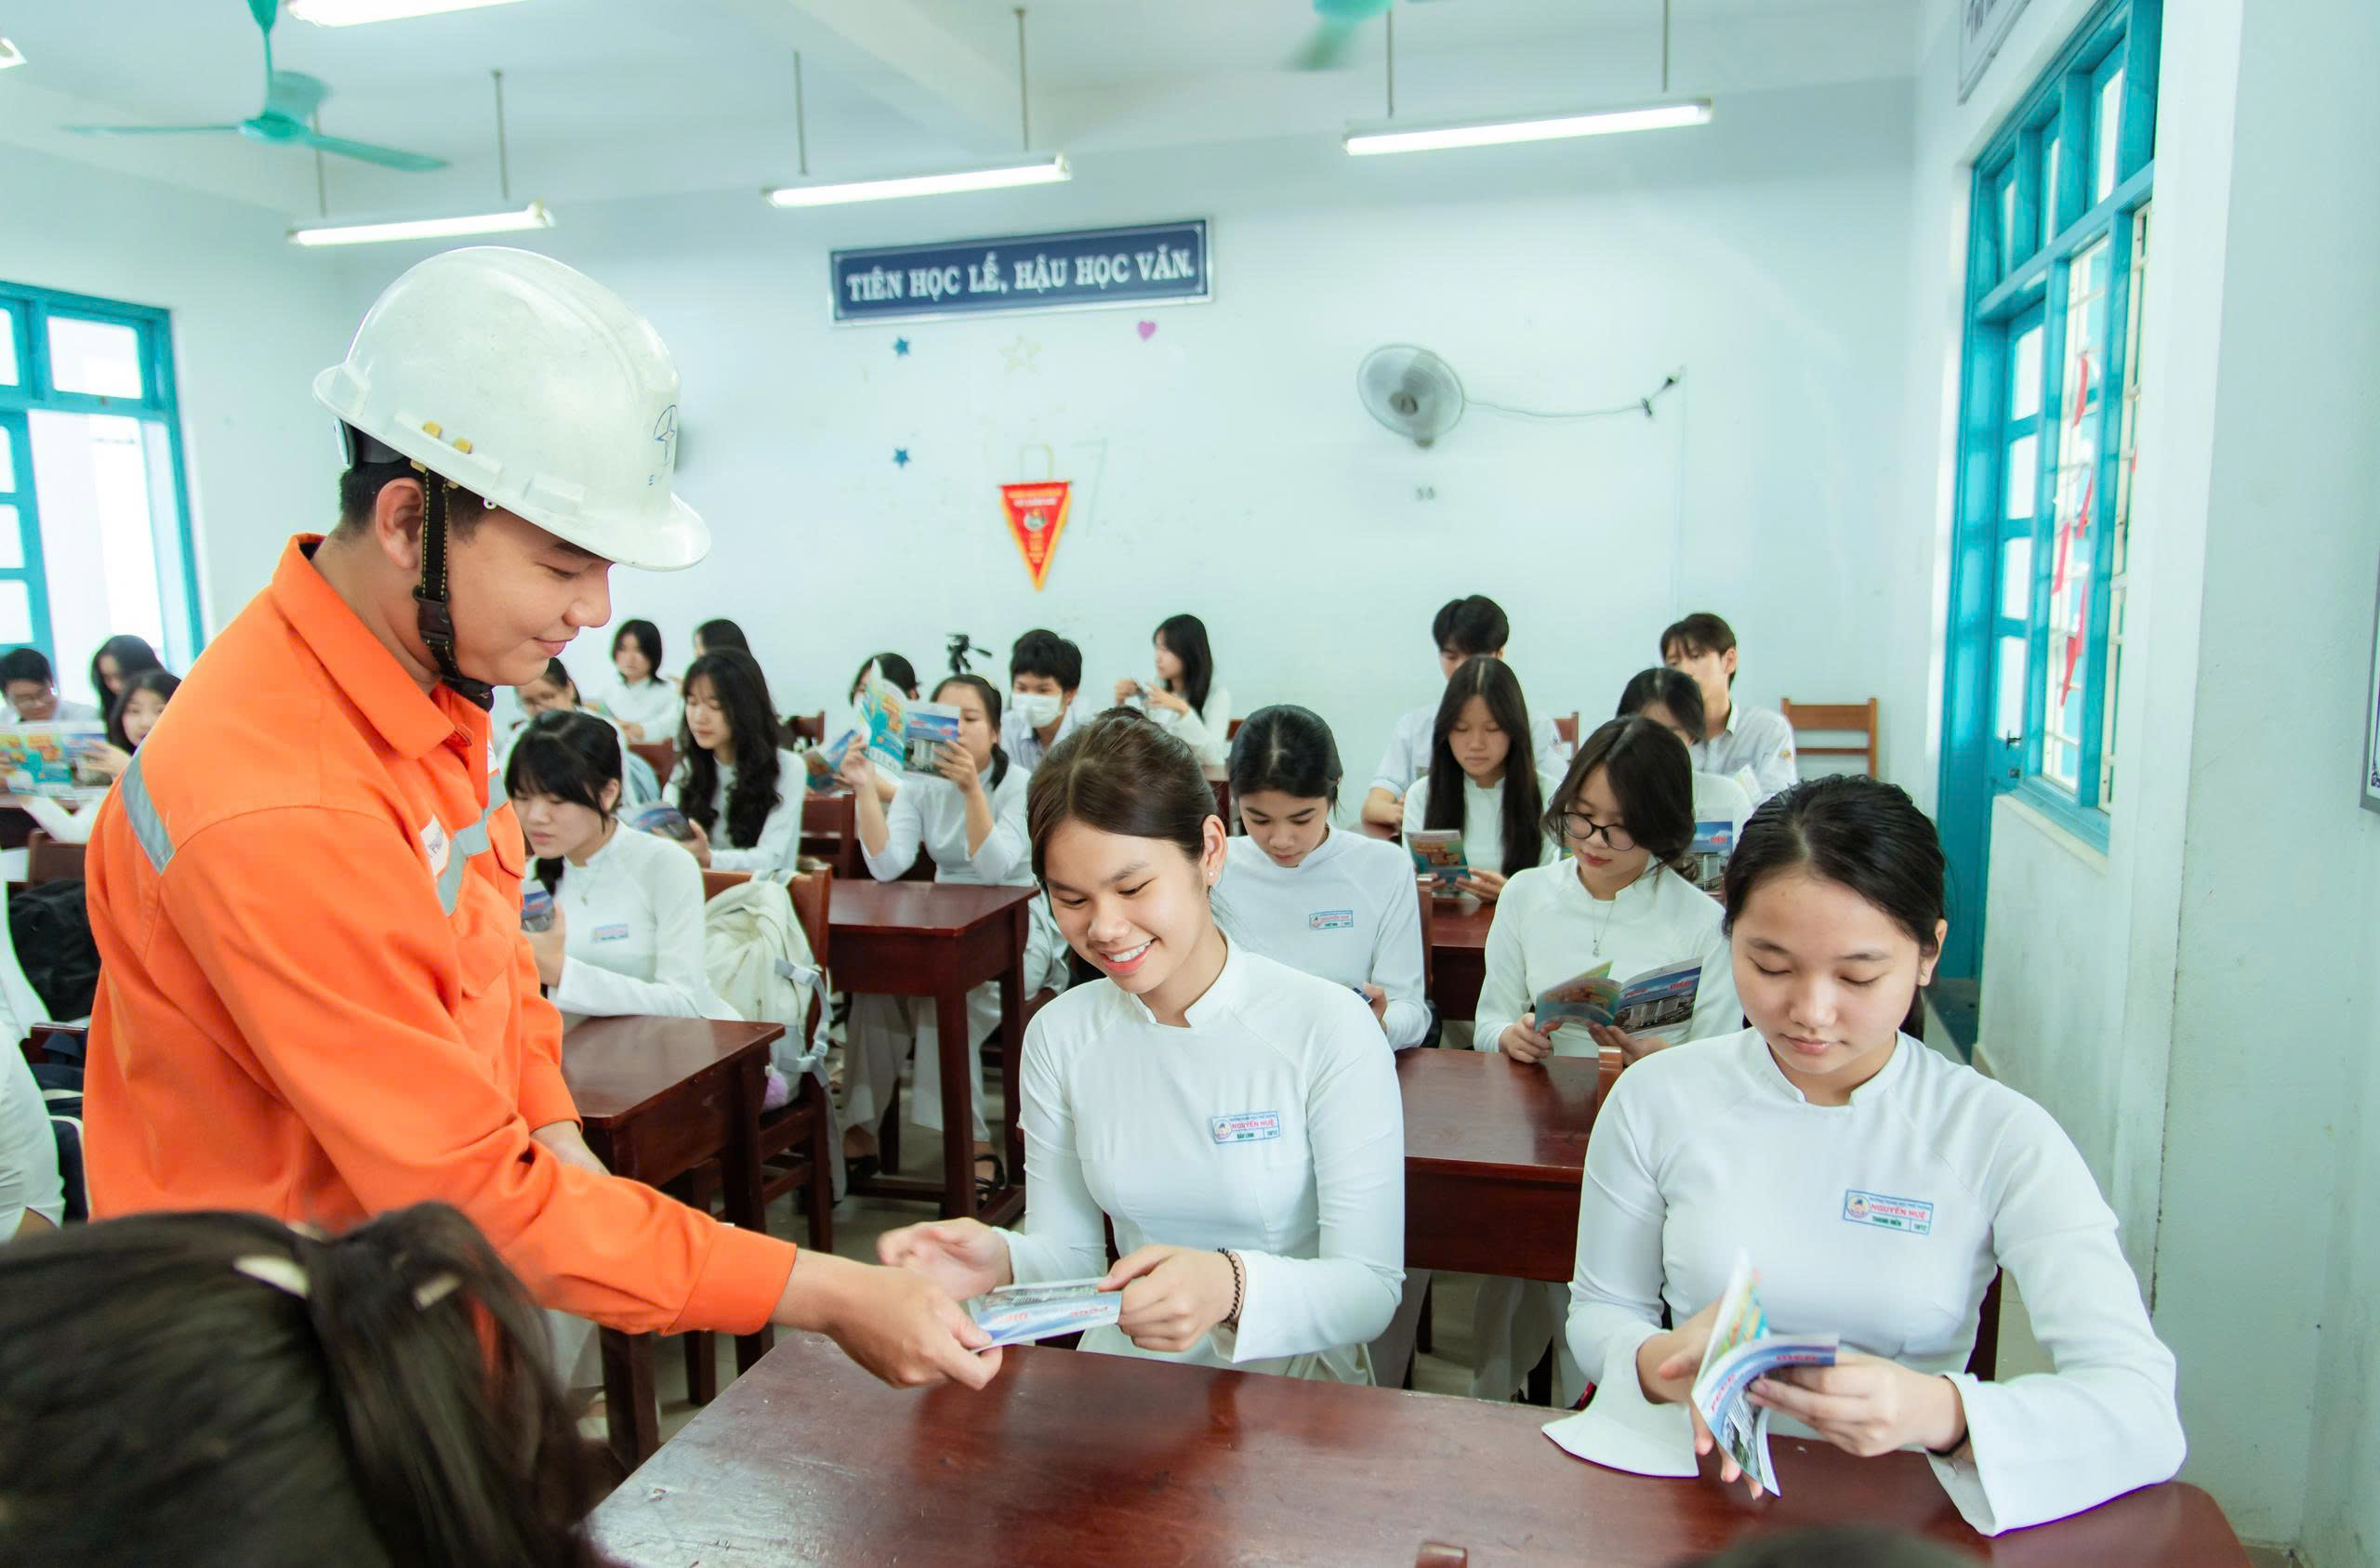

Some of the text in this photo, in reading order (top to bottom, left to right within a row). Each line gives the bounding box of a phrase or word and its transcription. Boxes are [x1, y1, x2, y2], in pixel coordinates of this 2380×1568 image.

[846, 265, 903, 302] TIÊN
[908, 265, 961, 302] HỌC
[1013, 253, 1068, 294] HẬU
[1075, 252, 1130, 290] HỌC
[1134, 244, 1195, 281] VĂN.
